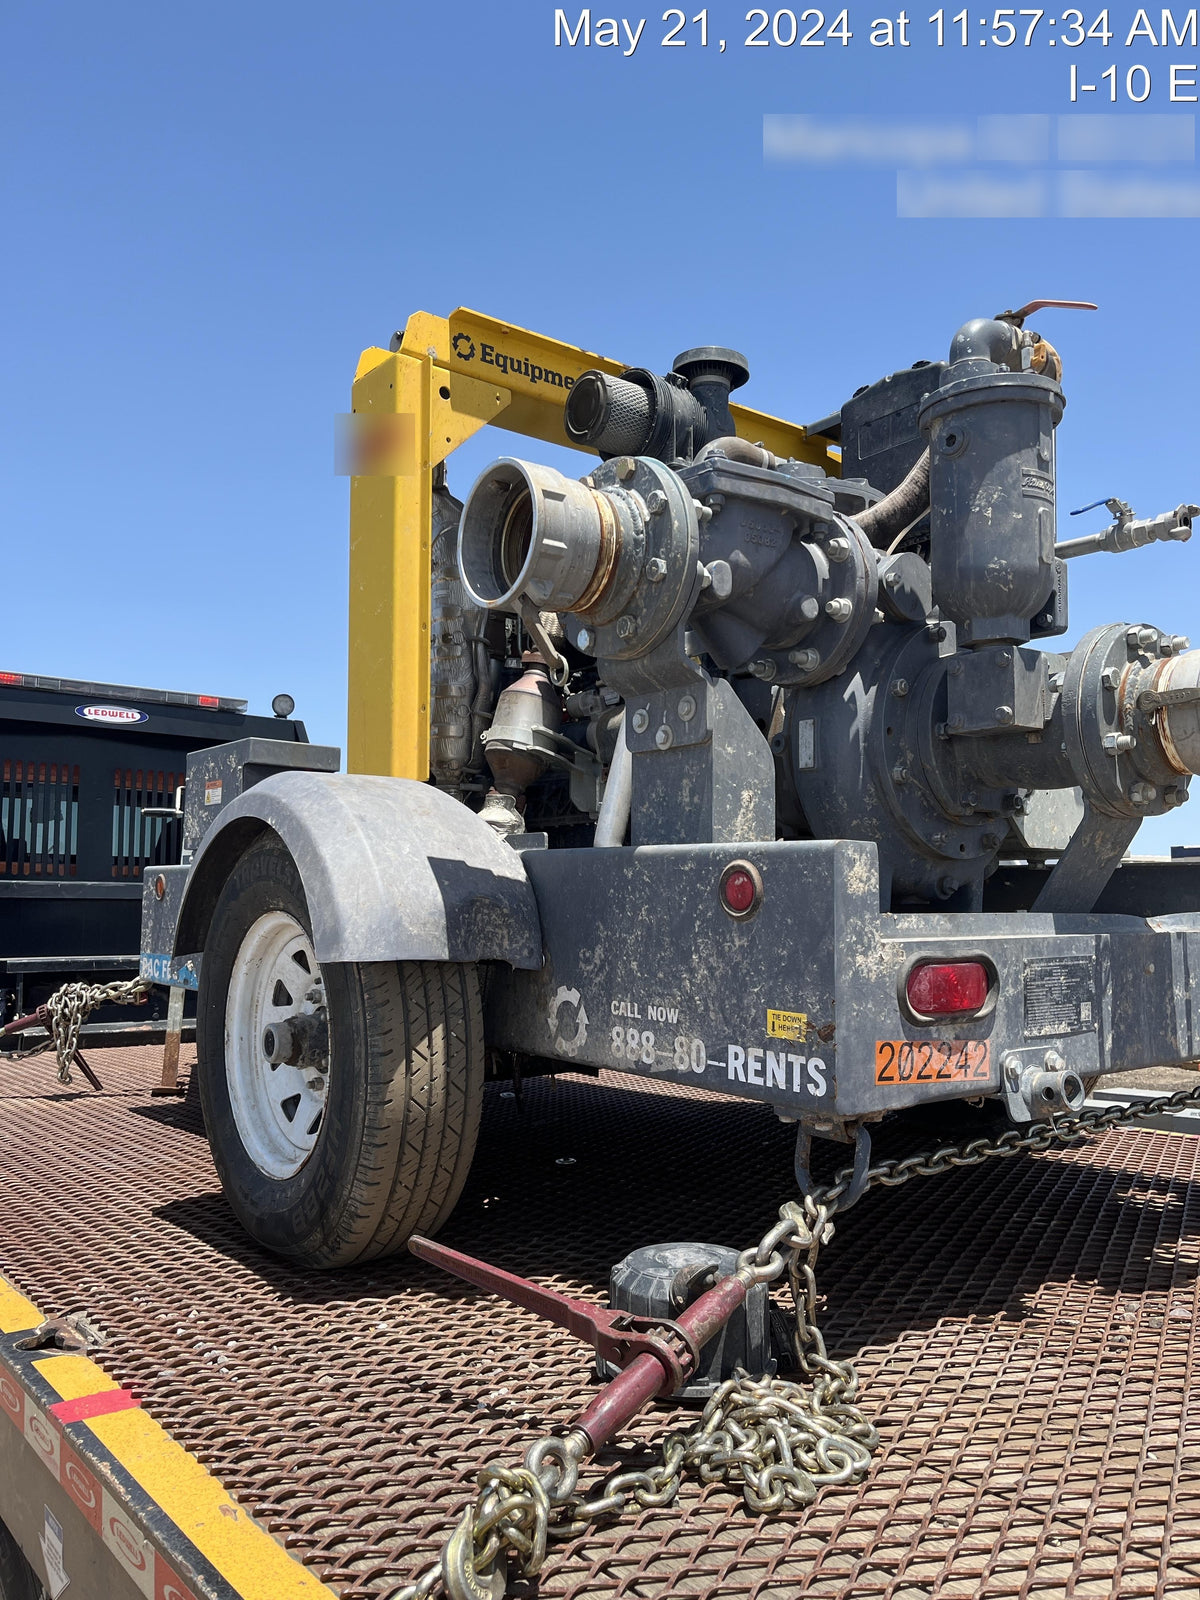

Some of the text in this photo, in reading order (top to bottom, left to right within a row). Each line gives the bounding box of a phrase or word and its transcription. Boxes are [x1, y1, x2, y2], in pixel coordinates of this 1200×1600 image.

[87, 708, 137, 720] LEDWELL
[610, 1000, 679, 1024] CALL NOW
[771, 1013, 802, 1024] TIE DOWN
[877, 1040, 988, 1082] 202242
